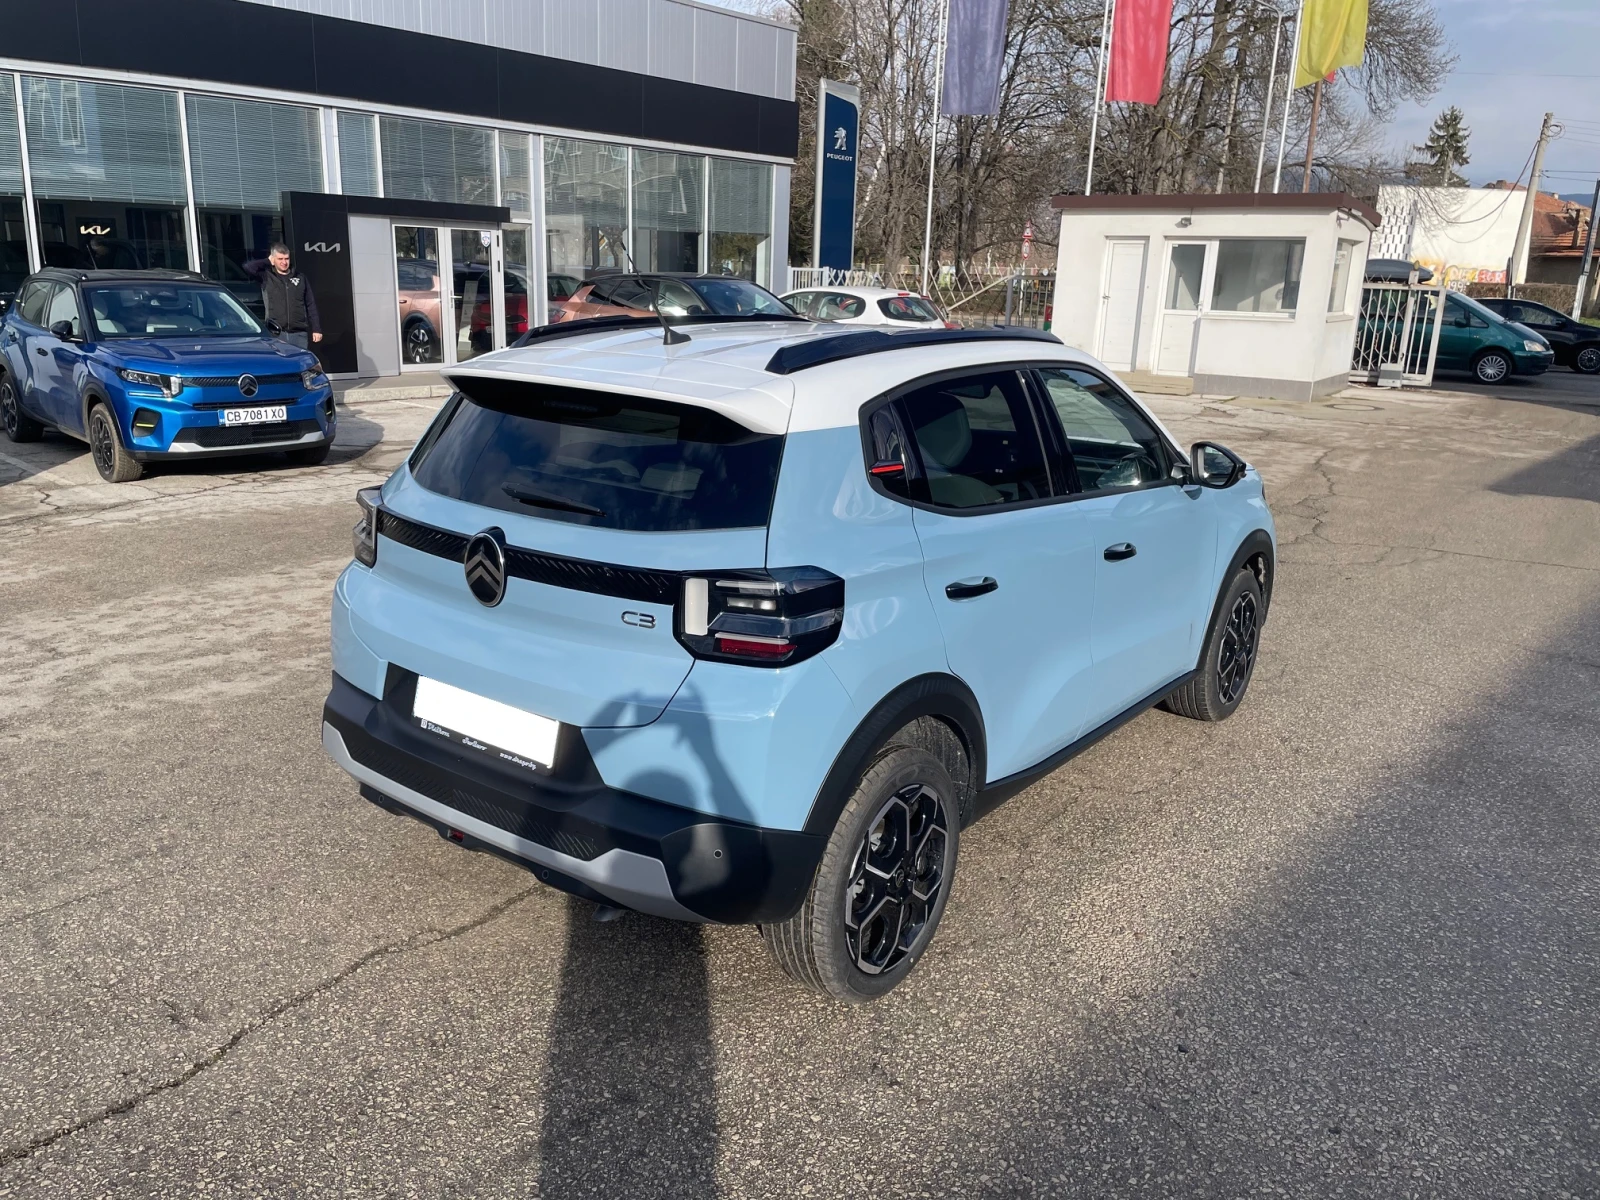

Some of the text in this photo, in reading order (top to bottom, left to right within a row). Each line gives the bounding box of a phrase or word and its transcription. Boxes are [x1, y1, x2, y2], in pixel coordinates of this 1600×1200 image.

[826, 152, 853, 161] PEUGEOT
[304, 241, 341, 253] KIA
[243, 409, 269, 420] 7081
[620, 610, 656, 629] C3
